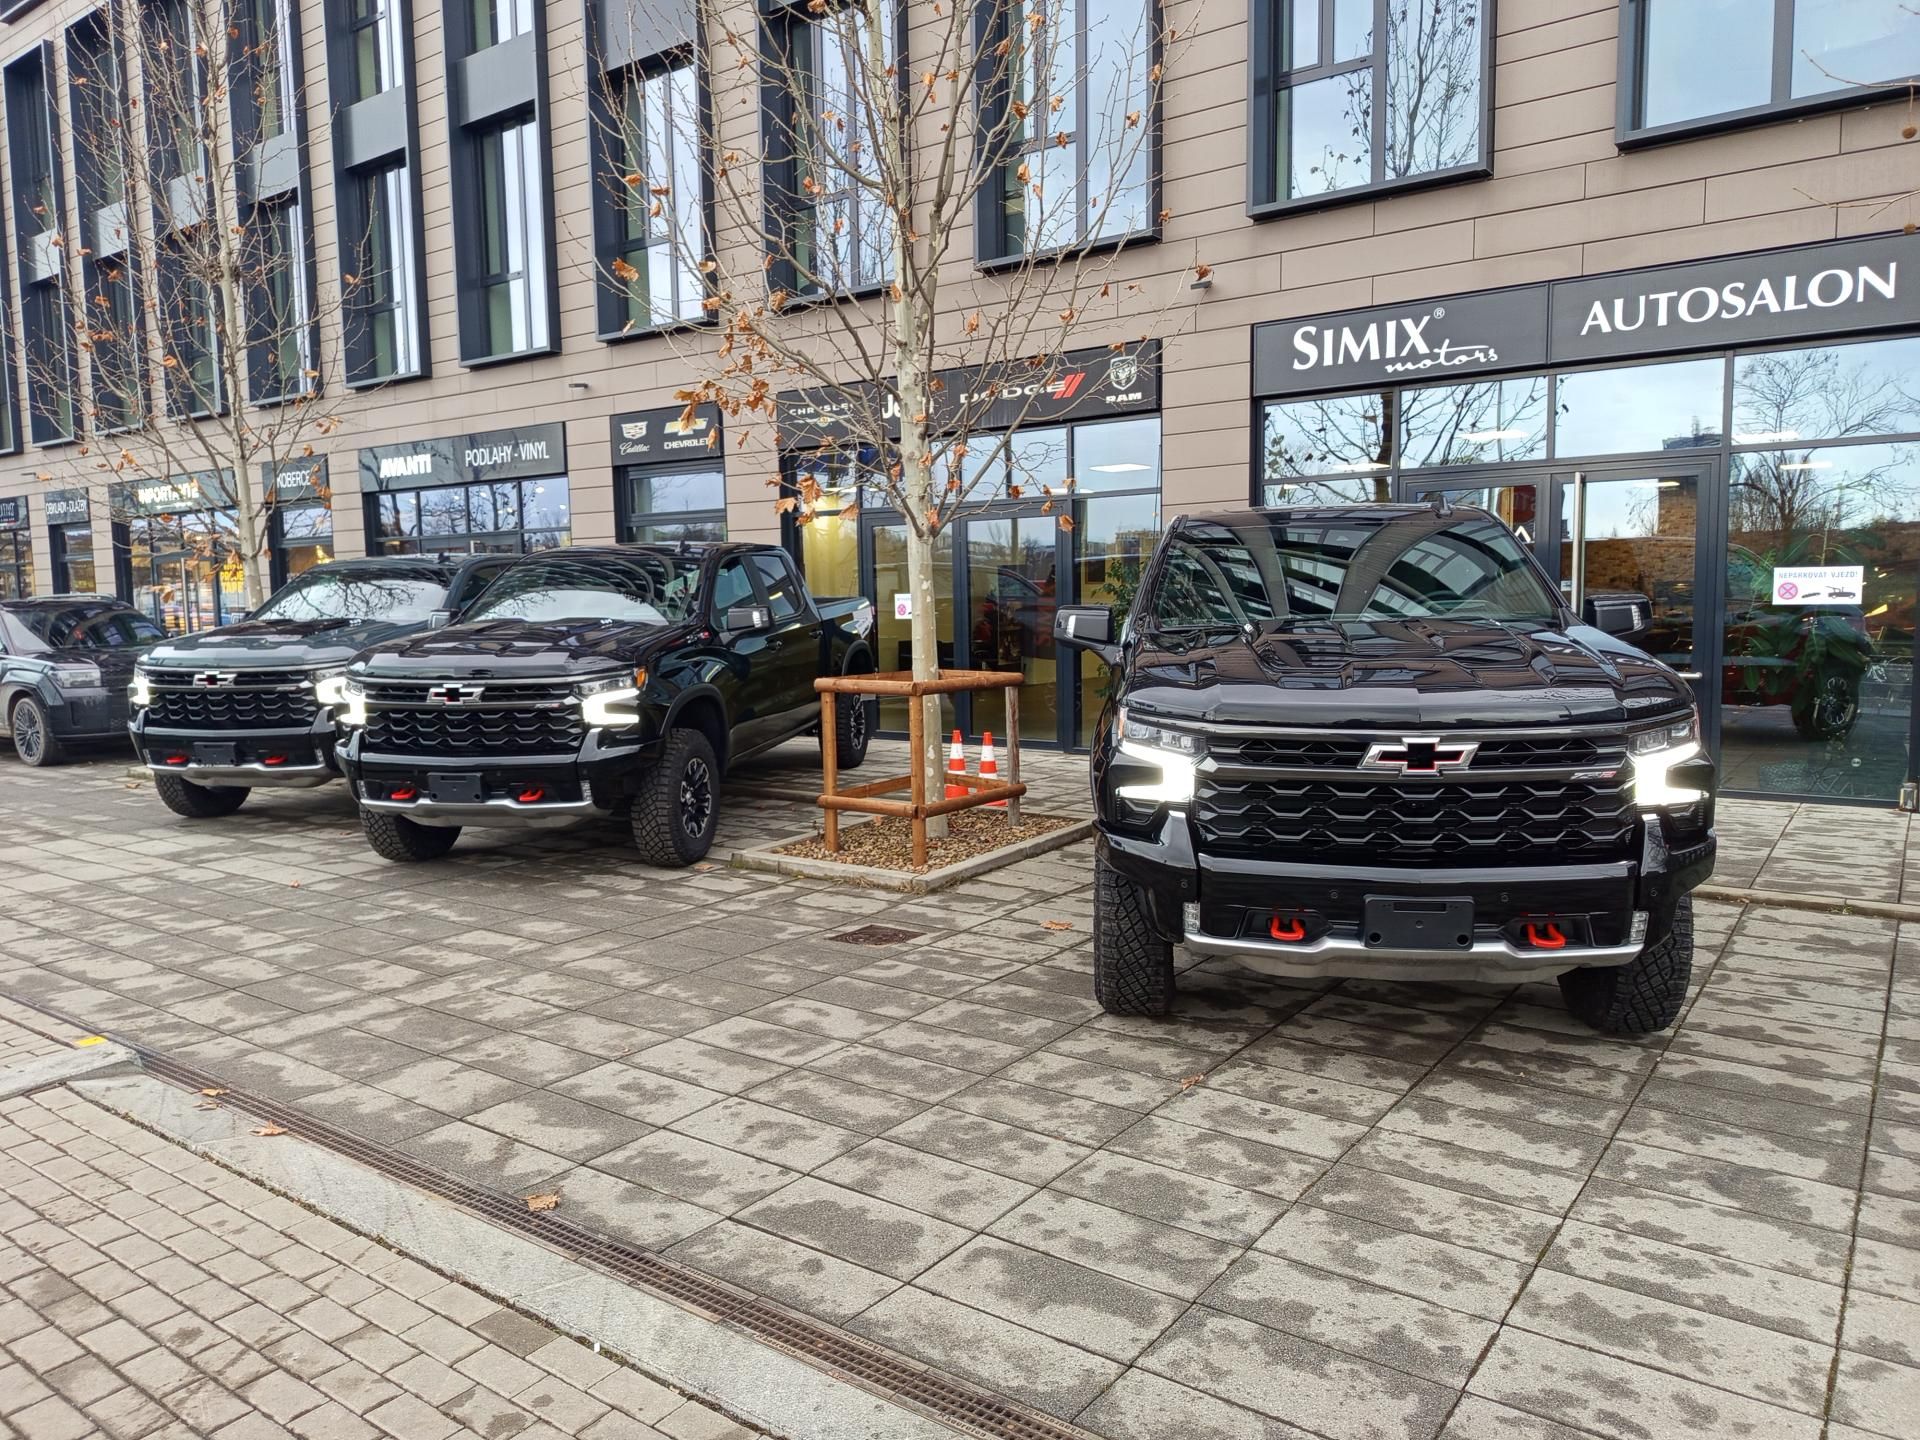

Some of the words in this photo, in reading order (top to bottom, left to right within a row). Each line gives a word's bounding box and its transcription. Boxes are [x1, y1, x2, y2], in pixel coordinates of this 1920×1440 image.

[1580, 261, 1897, 336] AUTOSALON
[1292, 315, 1431, 370] SIMIX
[1385, 338, 1498, 373] motors
[1106, 392, 1142, 404] RAM
[789, 401, 859, 417] CHRSLE
[663, 437, 710, 450] CHEVROLET
[465, 445, 512, 468] PODLAHY
[519, 441, 550, 461] VINYL
[380, 454, 432, 478] AVANTI
[276, 470, 311, 488] KOBERCE
[1778, 571, 1828, 579] NEPARKOVAT
